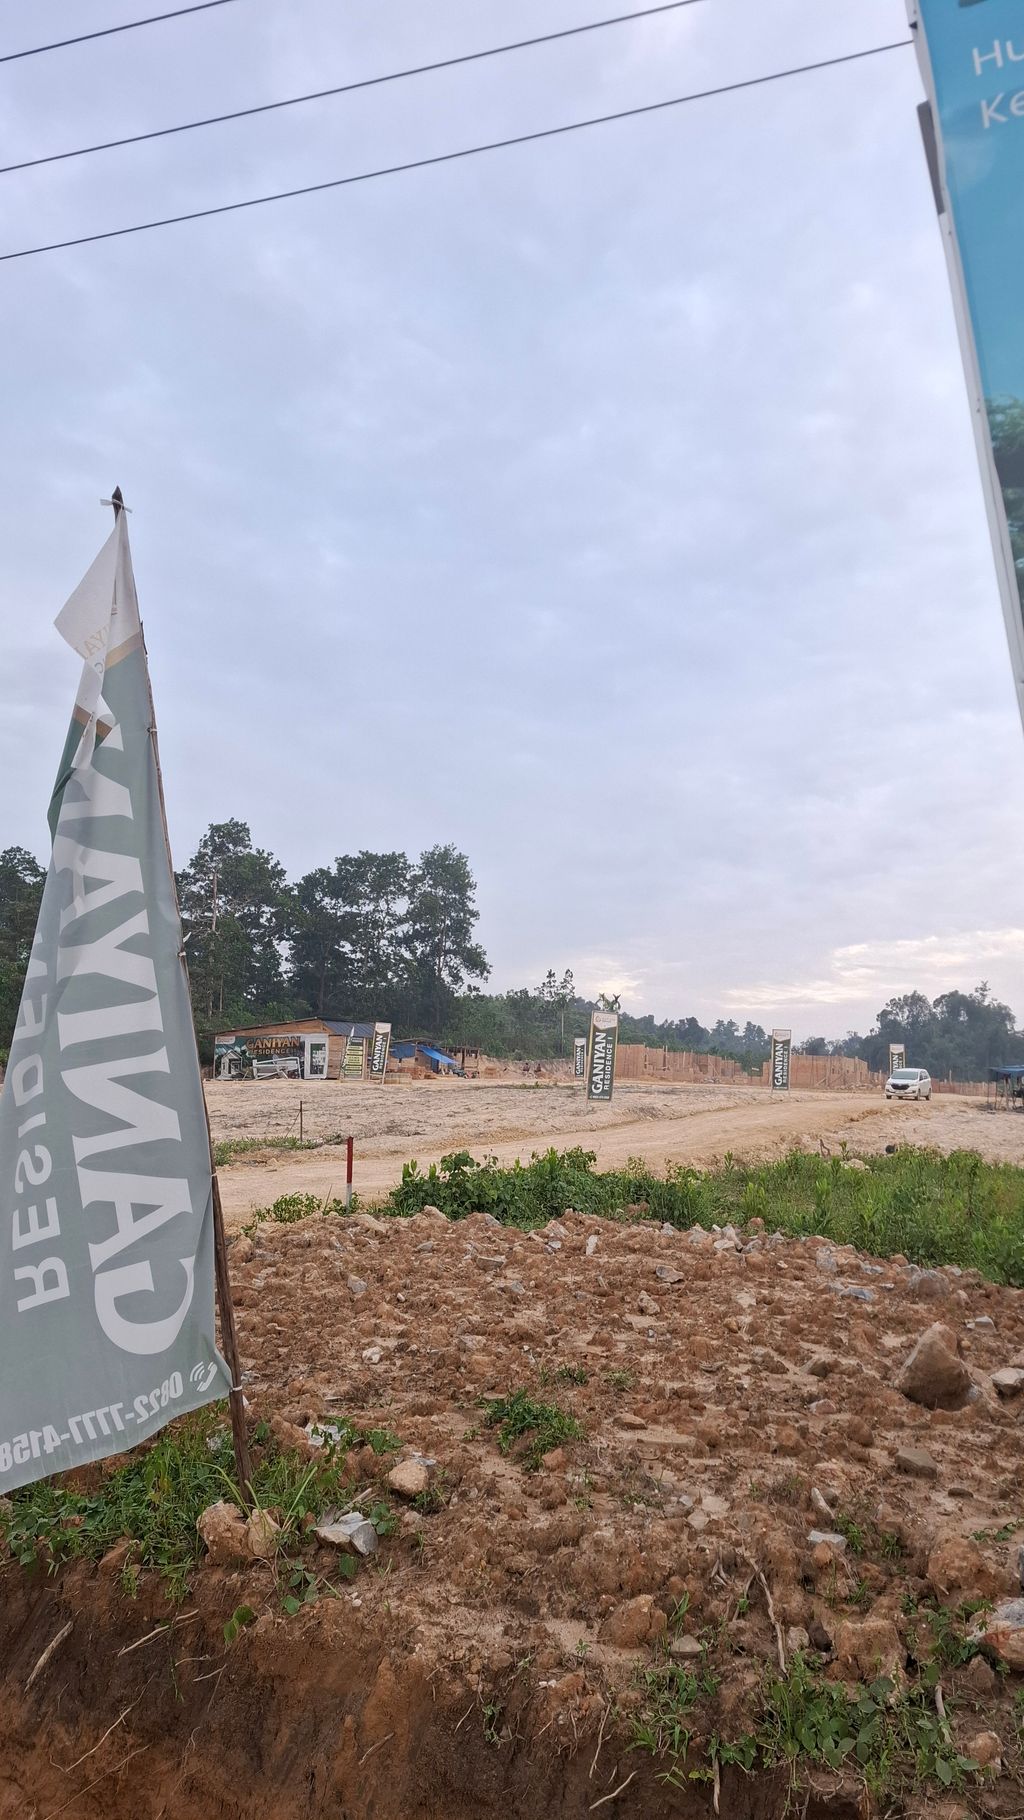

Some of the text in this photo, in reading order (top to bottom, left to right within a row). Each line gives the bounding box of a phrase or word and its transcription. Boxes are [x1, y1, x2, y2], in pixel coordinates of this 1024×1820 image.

[246, 1036, 301, 1050] GANIYAN
[372, 1034, 383, 1071] GANIYAN
[592, 1032, 607, 1094] GANIYAN
[775, 1043, 783, 1085] GANIYAN
[604, 1043, 613, 1090] RESIDENCE
